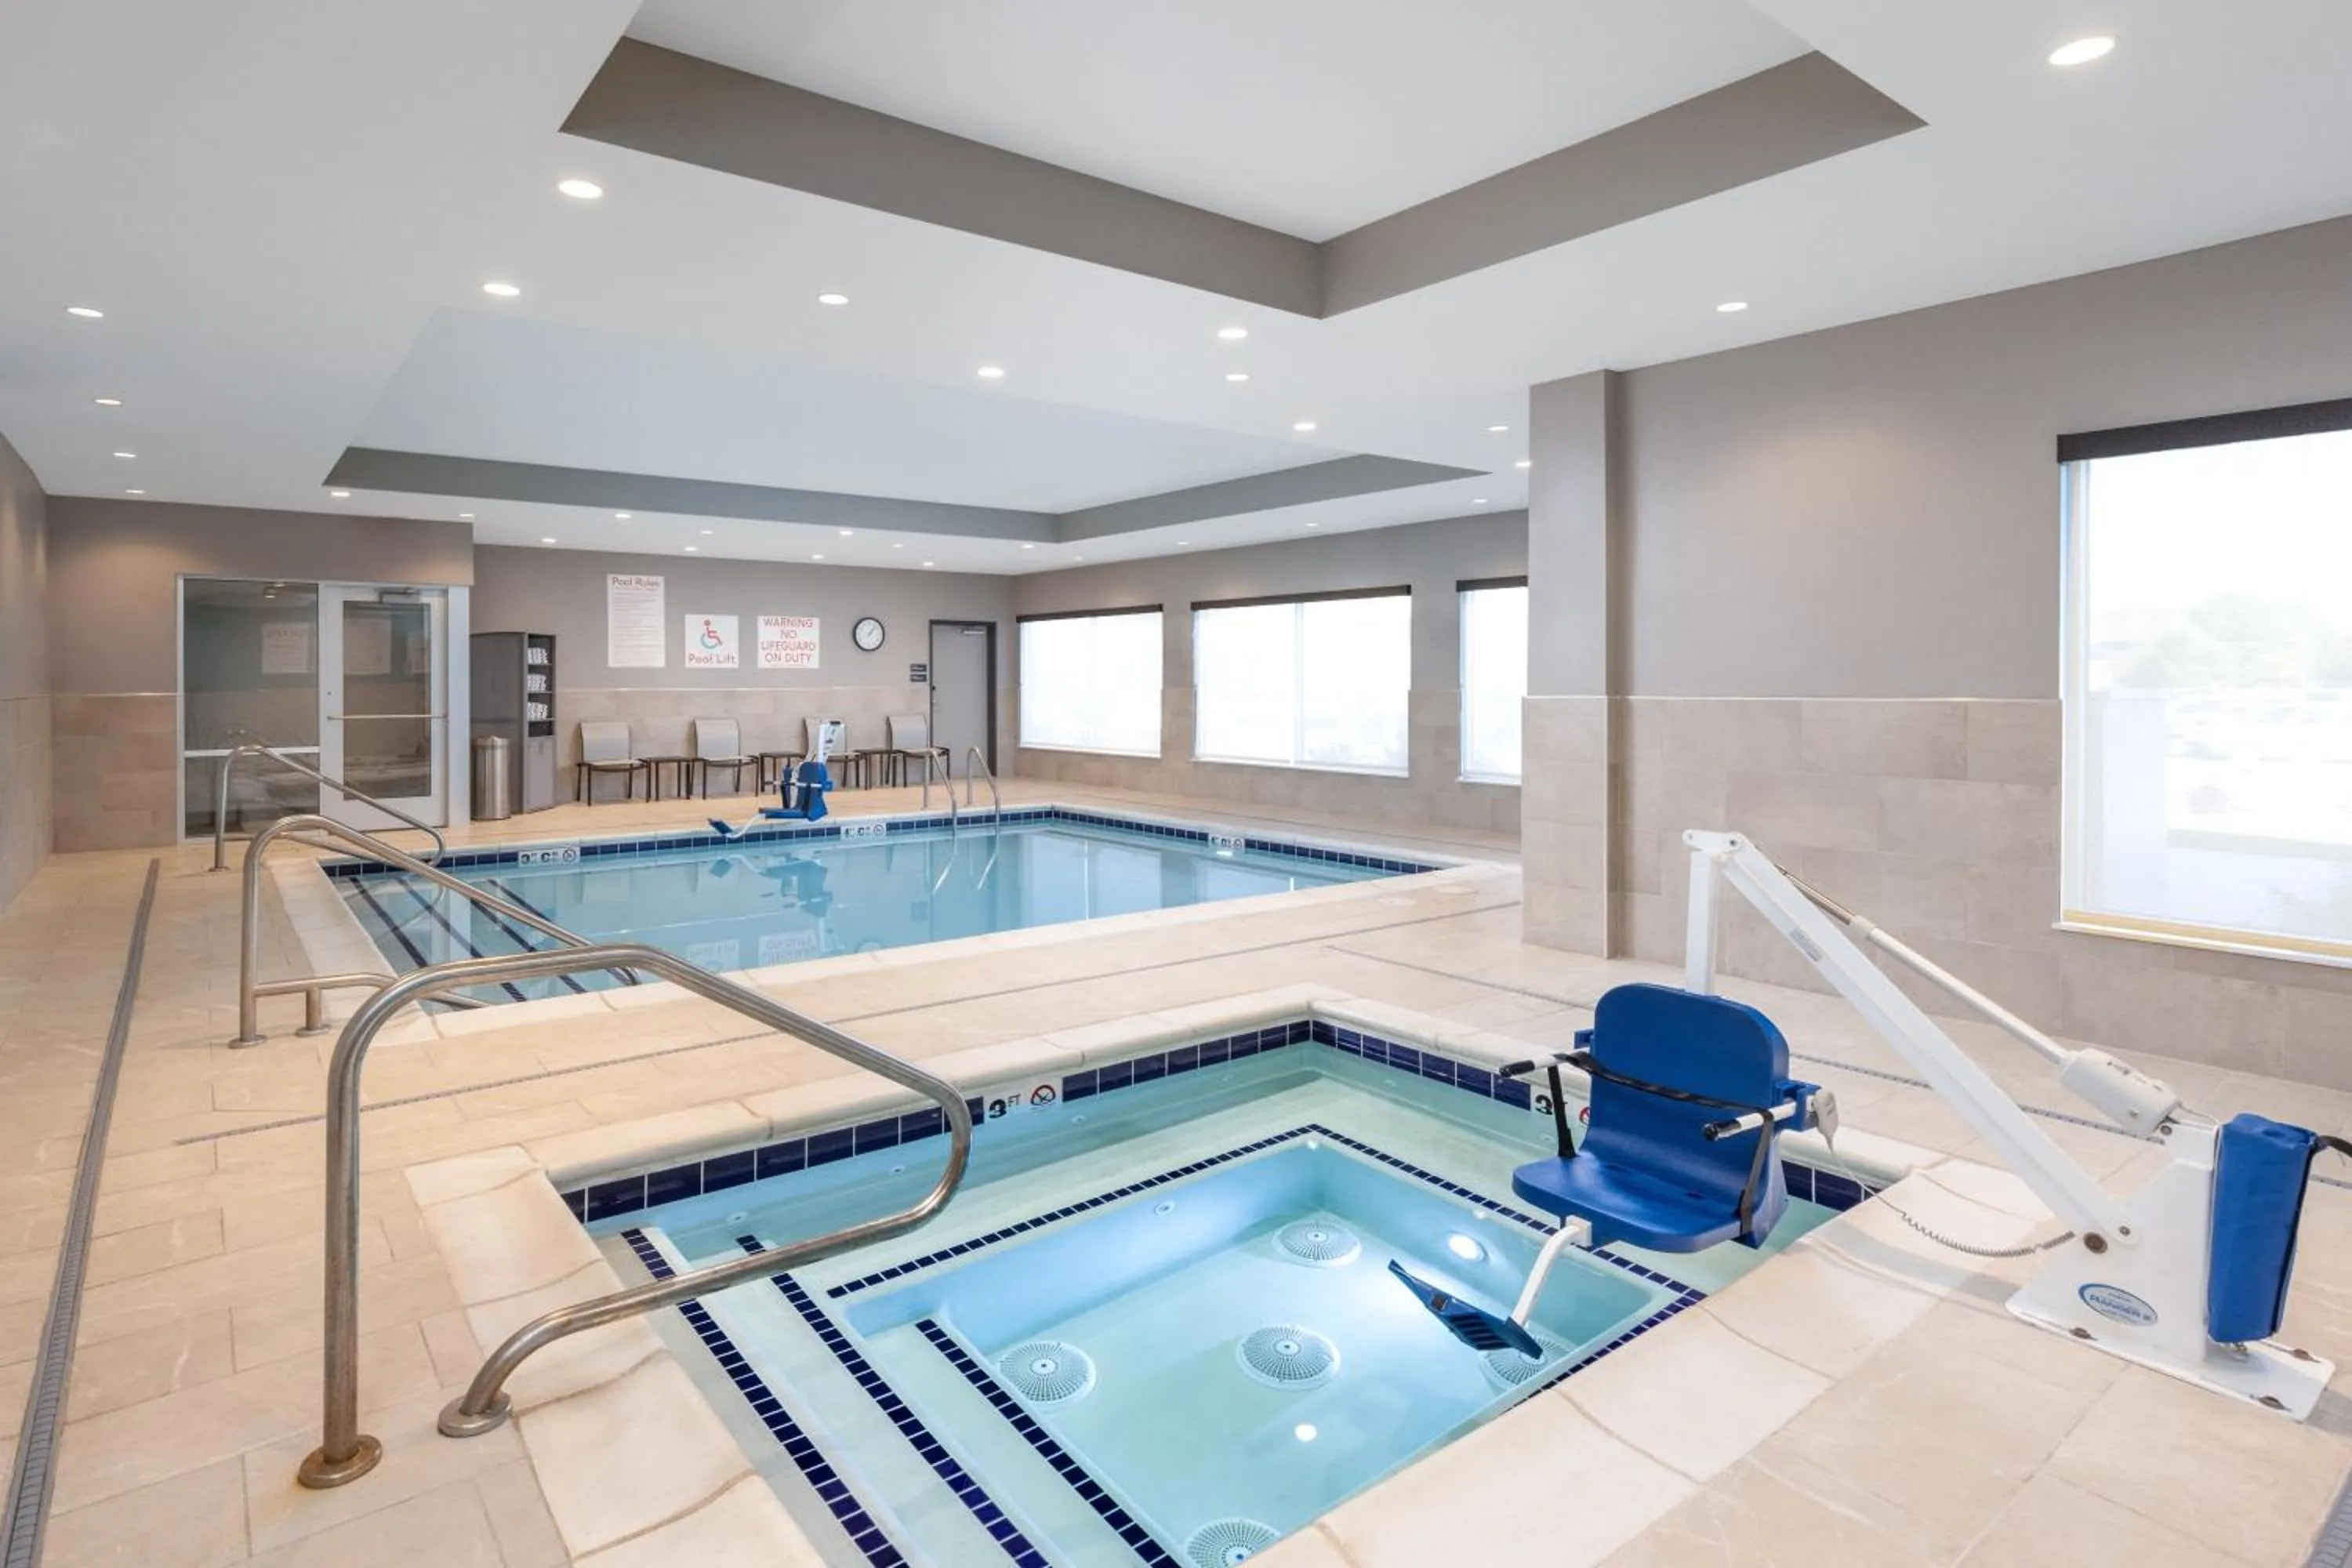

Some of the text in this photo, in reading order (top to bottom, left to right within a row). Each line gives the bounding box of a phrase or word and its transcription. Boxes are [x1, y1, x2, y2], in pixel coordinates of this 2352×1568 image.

[763, 617, 813, 628] WARNING
[780, 629, 797, 639] NO
[761, 641, 816, 652] LIFEGUARD
[688, 653, 736, 665] Pool Lift
[764, 652, 811, 663] ON DUTY
[989, 1093, 1022, 1119] 3 FT
